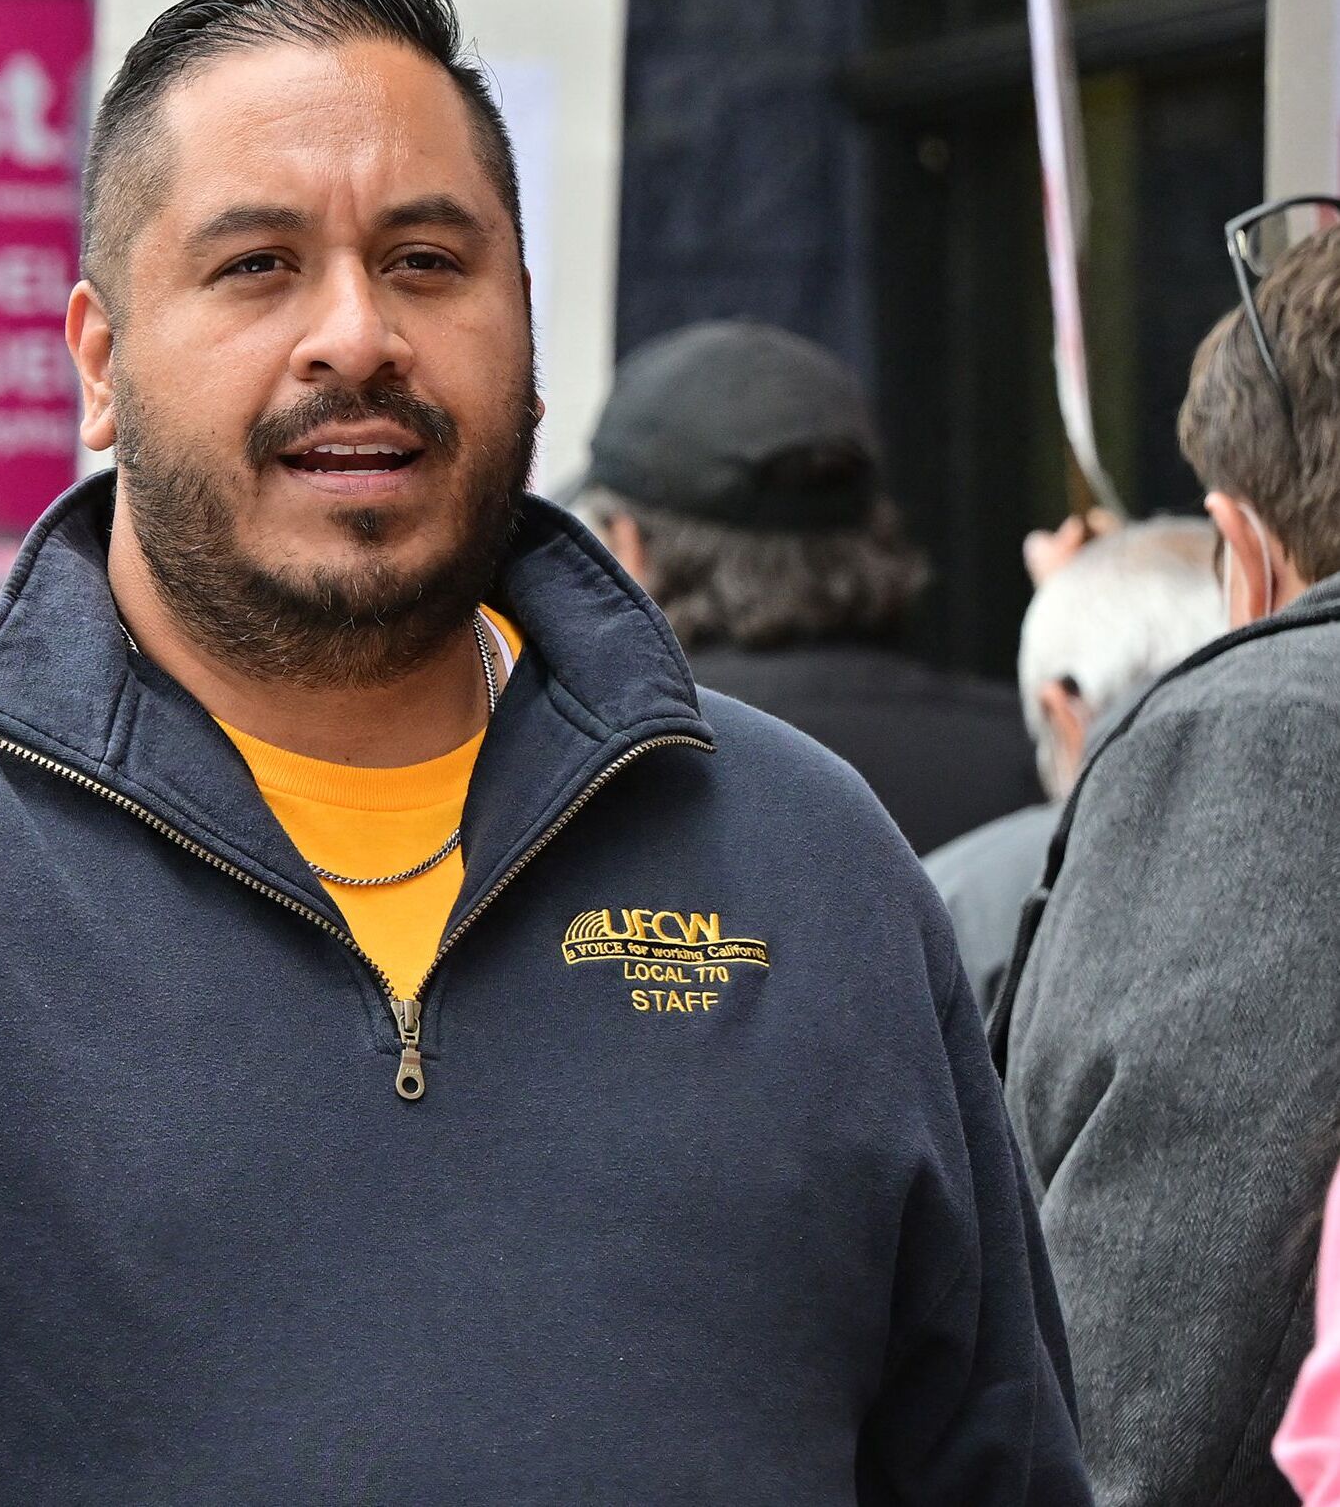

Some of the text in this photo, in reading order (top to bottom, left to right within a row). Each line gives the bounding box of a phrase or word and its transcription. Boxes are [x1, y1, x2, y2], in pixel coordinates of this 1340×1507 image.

[602, 908, 720, 943] UFCW
[575, 942, 625, 956] VOICE
[627, 942, 649, 955] for
[651, 947, 705, 963] working
[624, 962, 730, 983] LOCAL 770
[631, 989, 719, 1012] STAFF
